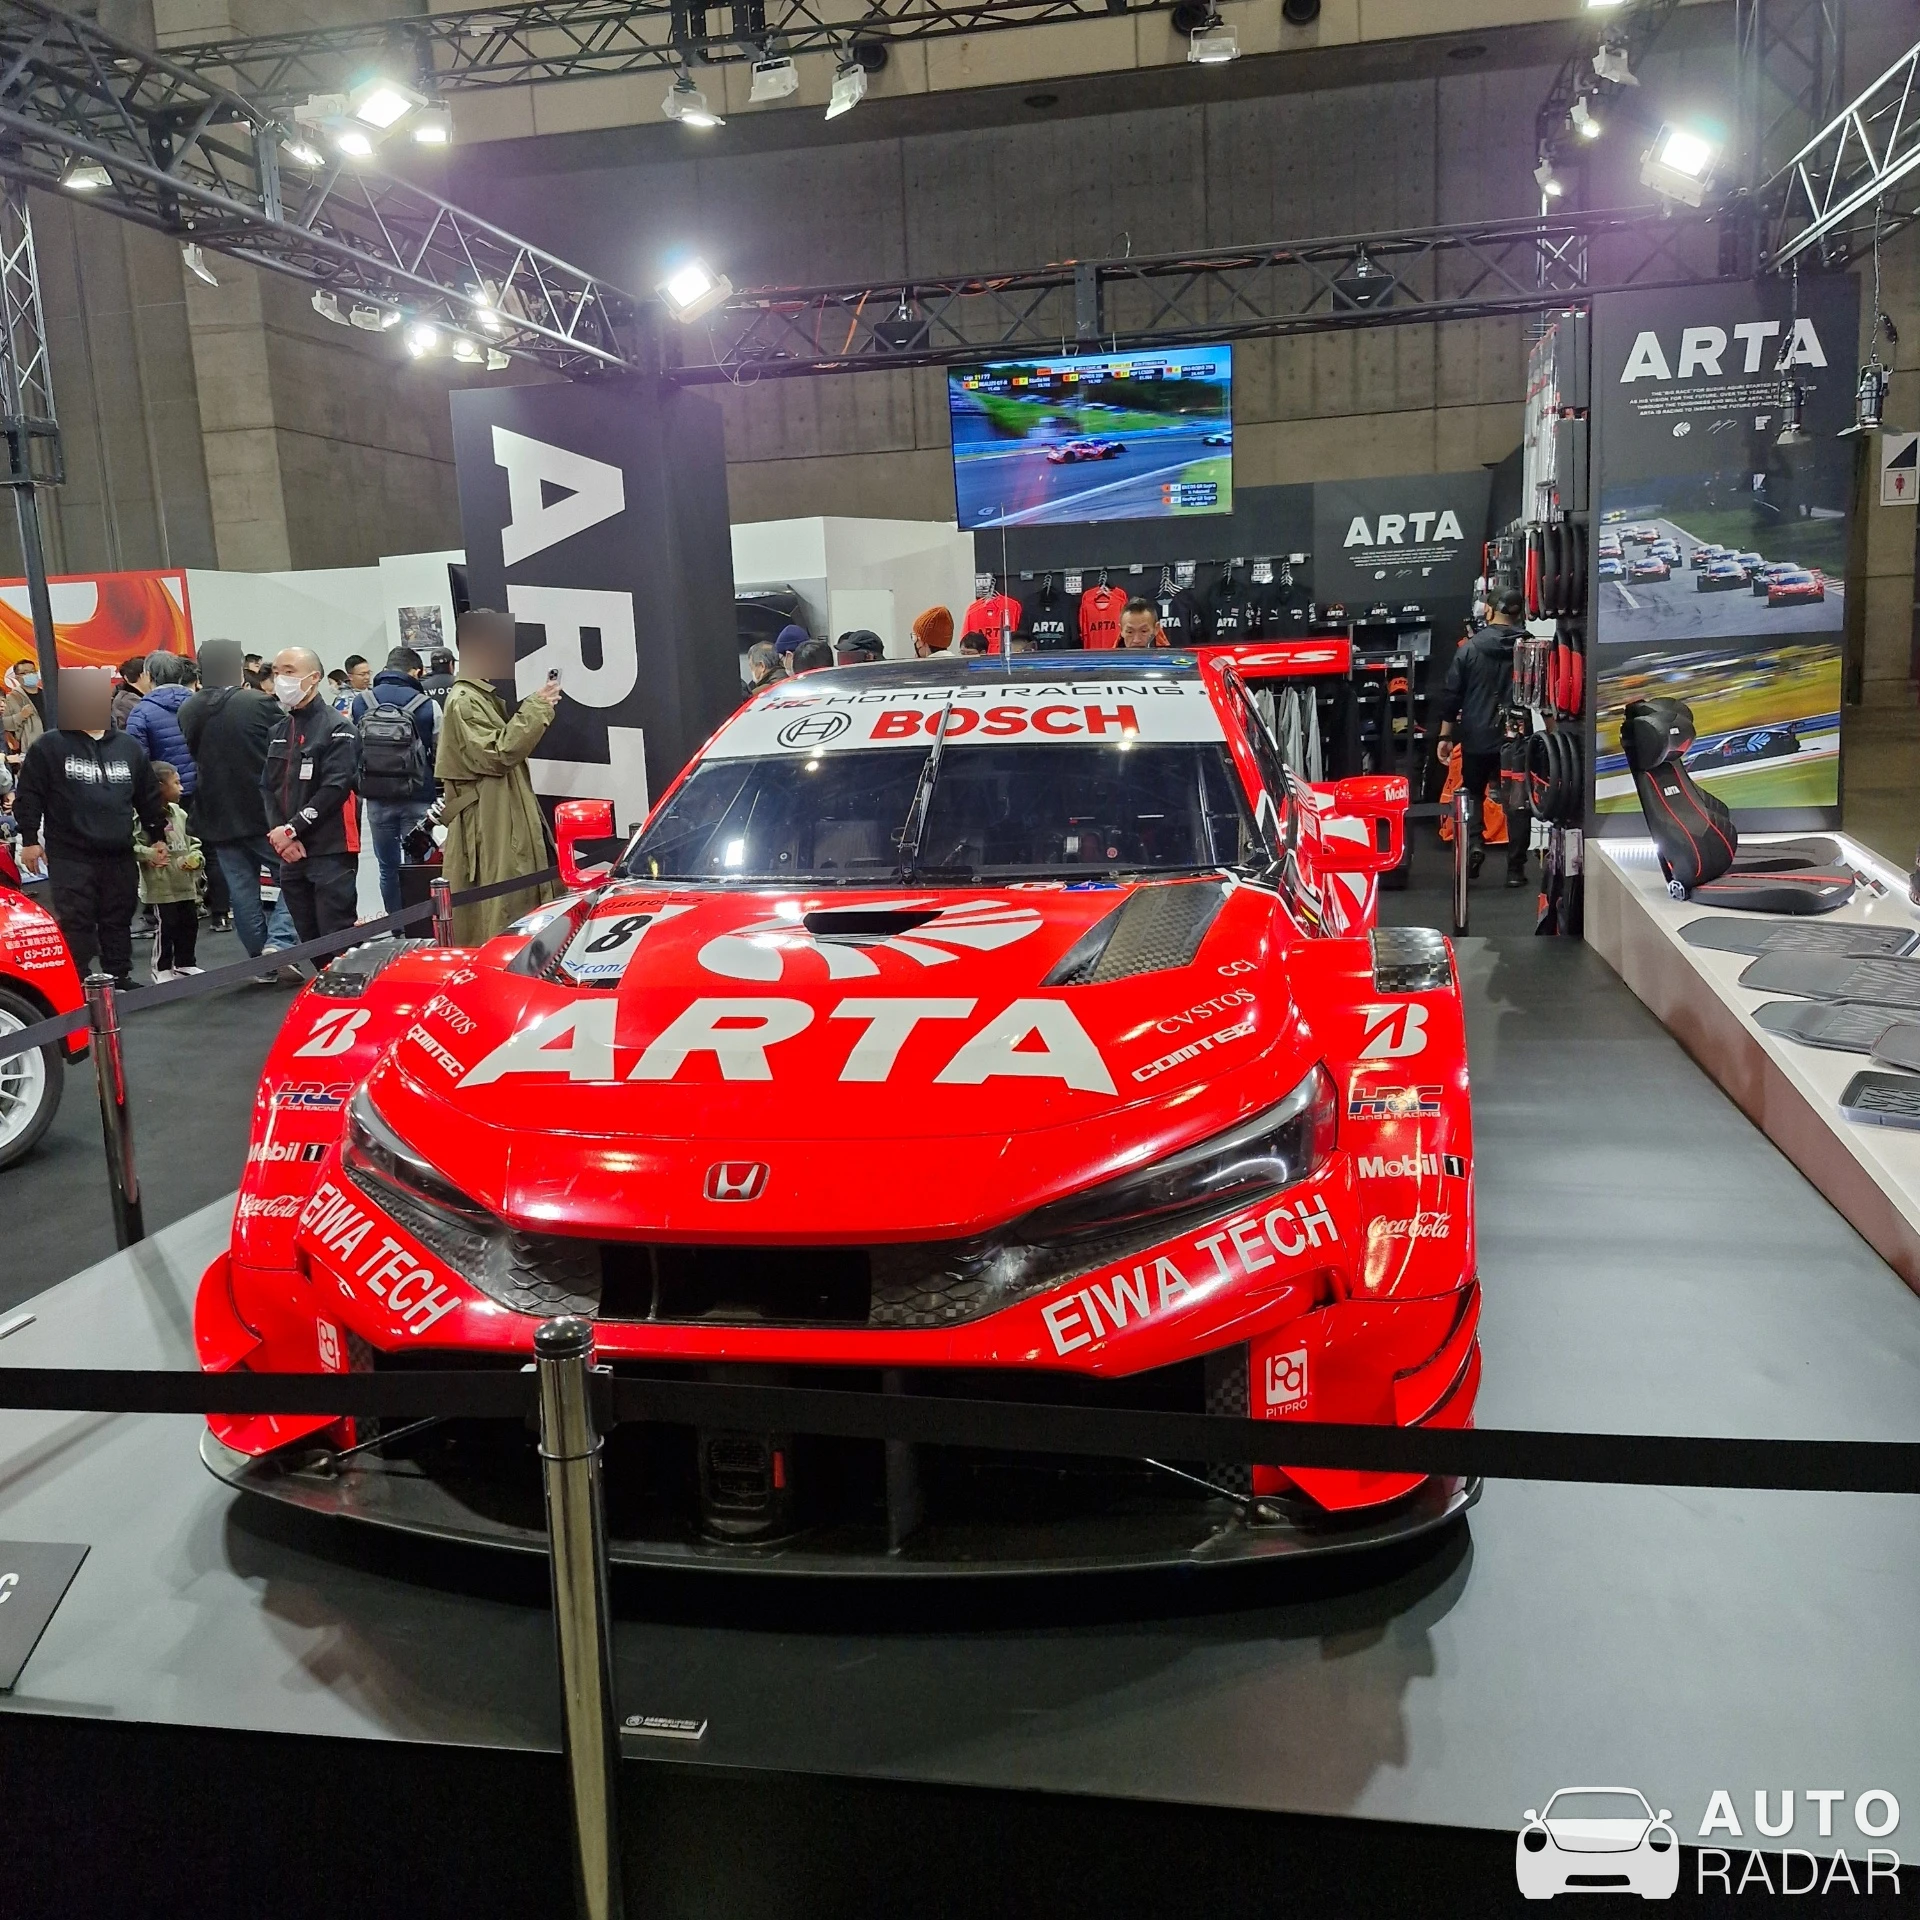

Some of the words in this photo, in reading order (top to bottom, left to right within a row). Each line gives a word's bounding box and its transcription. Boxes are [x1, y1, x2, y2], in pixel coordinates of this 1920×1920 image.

[1620, 318, 1828, 383] ARTA
[1343, 510, 1464, 548] ARTA
[1032, 621, 1064, 633] ARTA
[1090, 621, 1116, 631] ARTA
[827, 688, 986, 706] Honda
[1001, 685, 1184, 697] RACING
[869, 704, 1141, 740] BOSCH
[585, 915, 653, 953] 8
[22, 960, 66, 970] Pioneer
[1156, 988, 1256, 1034] CVSTOS
[456, 997, 1119, 1096] ARTA
[275, 1081, 355, 1106] HRC
[1348, 1085, 1444, 1115] HRC
[1348, 1113, 1392, 1121] Honda
[1358, 1153, 1438, 1179] Mobil
[300, 1181, 375, 1263] EIWA
[355, 1236, 462, 1335] TECH
[1040, 1255, 1191, 1356] EIWA
[1195, 1193, 1339, 1285] TECH
[1266, 1399, 1308, 1418] PITPRO
